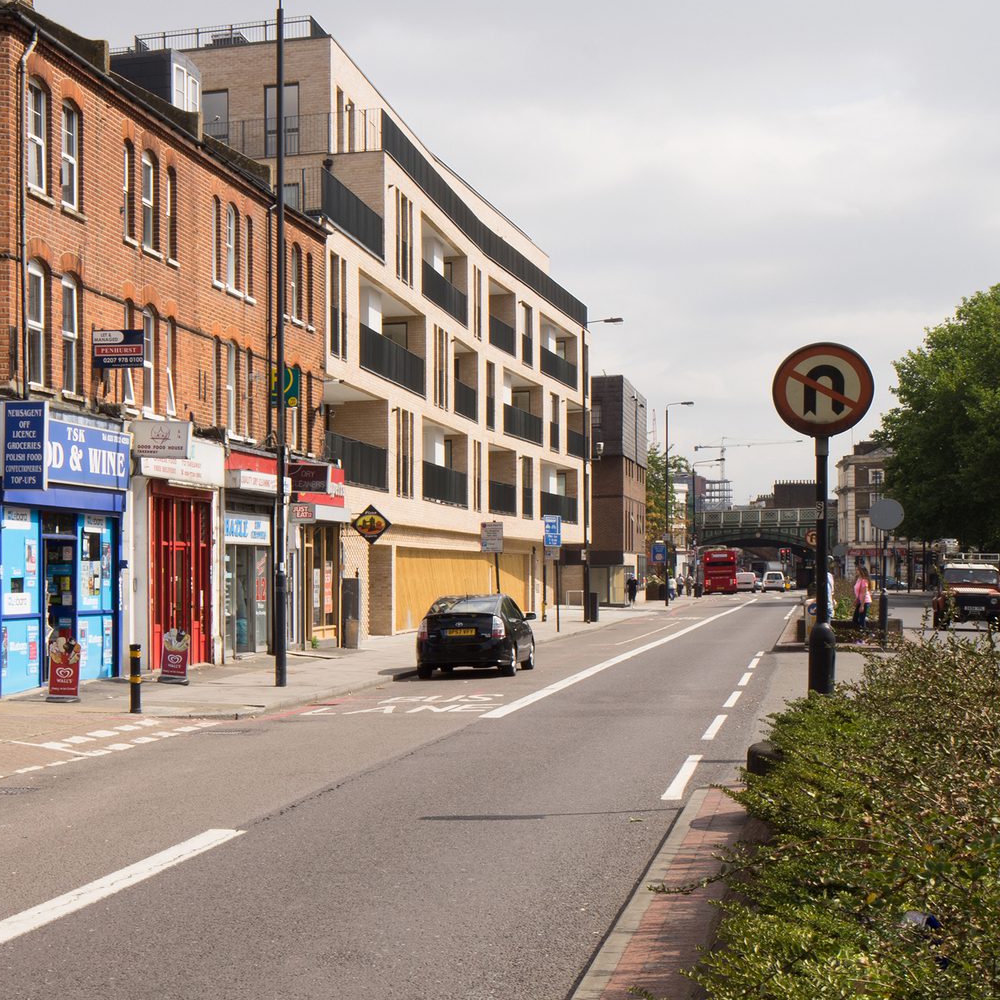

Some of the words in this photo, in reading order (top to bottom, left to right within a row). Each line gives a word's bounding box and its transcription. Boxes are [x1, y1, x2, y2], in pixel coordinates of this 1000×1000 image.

[7, 409, 42, 417] NEWSAGENT
[12, 430, 36, 439] LICENCE
[66, 427, 86, 442] TSK
[7, 442, 41, 450] GROCERIES
[5, 453, 25, 461] POLISH
[26, 453, 42, 461] FOOD
[69, 445, 83, 472] &
[87, 447, 126, 477] WINE
[10, 476, 37, 485] TOP-UPS
[301, 703, 503, 716] LANE
